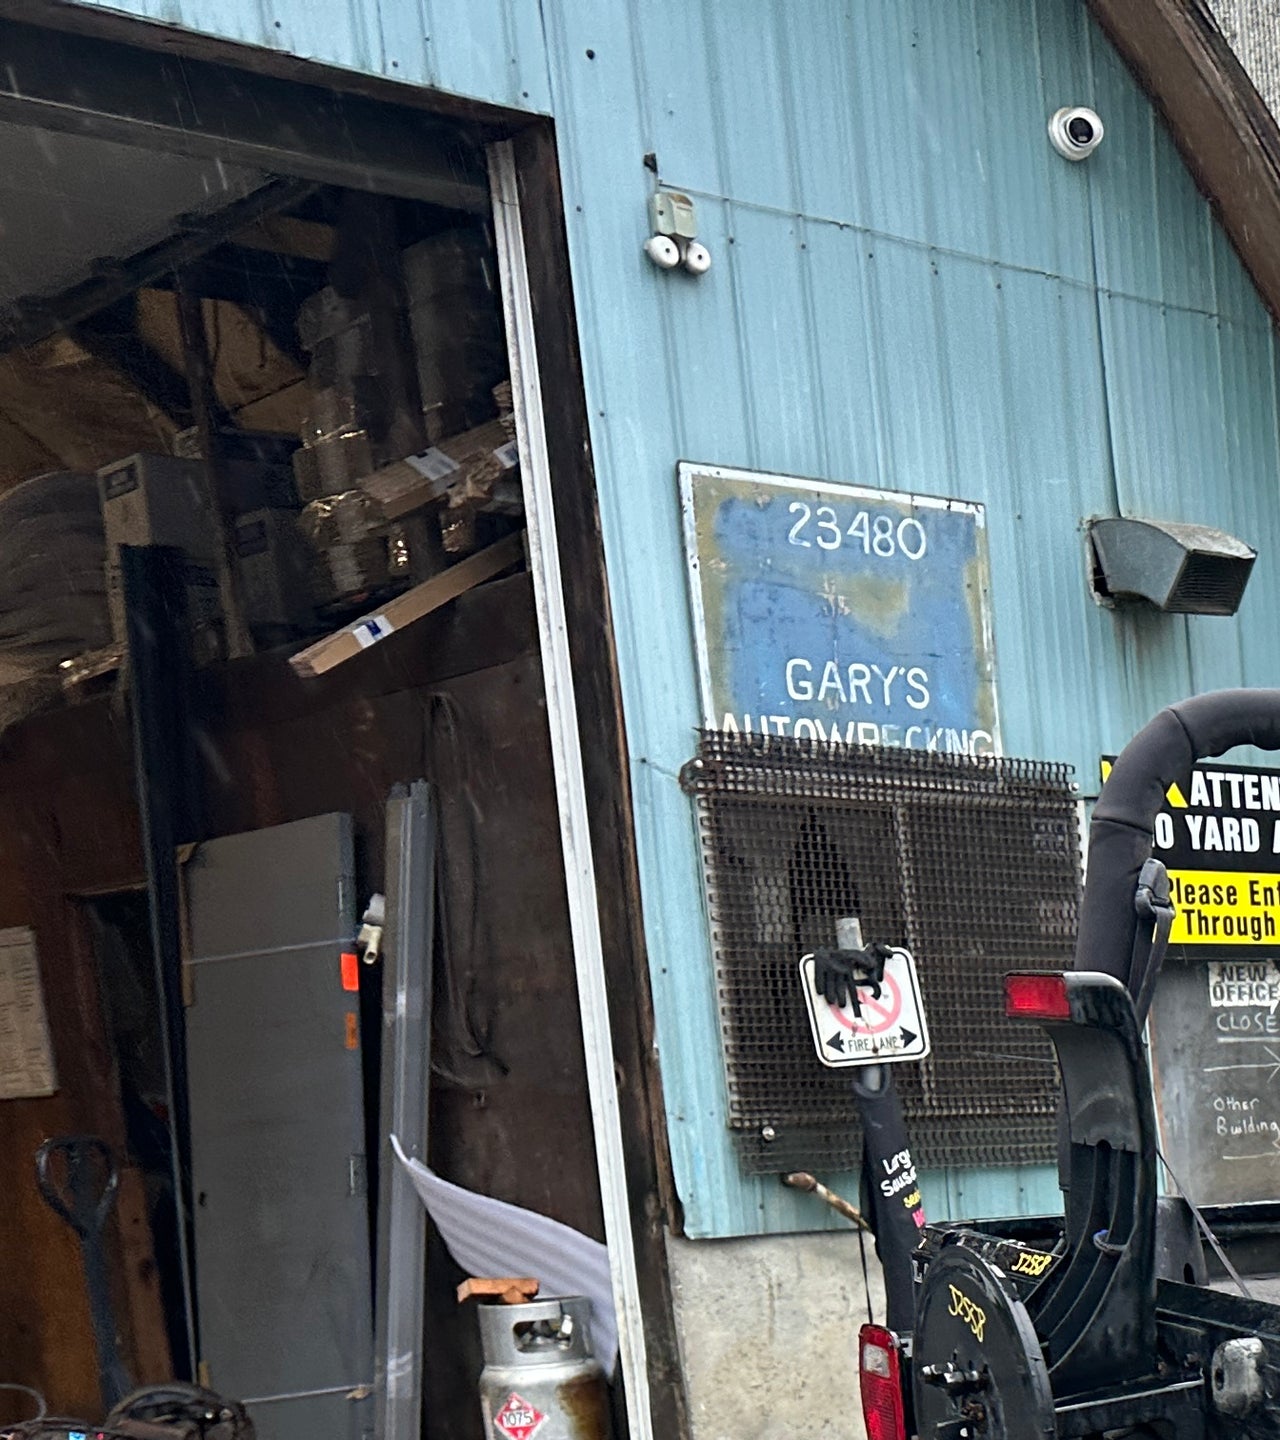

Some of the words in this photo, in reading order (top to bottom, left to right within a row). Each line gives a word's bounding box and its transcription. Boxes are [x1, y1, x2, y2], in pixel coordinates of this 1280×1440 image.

[787, 502, 927, 560] 23480
[785, 658, 930, 709] GARY'S
[1152, 812, 1175, 850] O
[1184, 814, 1260, 853] YARD
[1181, 909, 1276, 942] Through
[1219, 963, 1267, 983] NEW
[1212, 983, 1280, 1002] OFFICE
[848, 1038, 871, 1053] FIRE
[1213, 1097, 1260, 1113] Other
[946, 1284, 986, 1343] J2558
[503, 1411, 533, 1426] 1075
